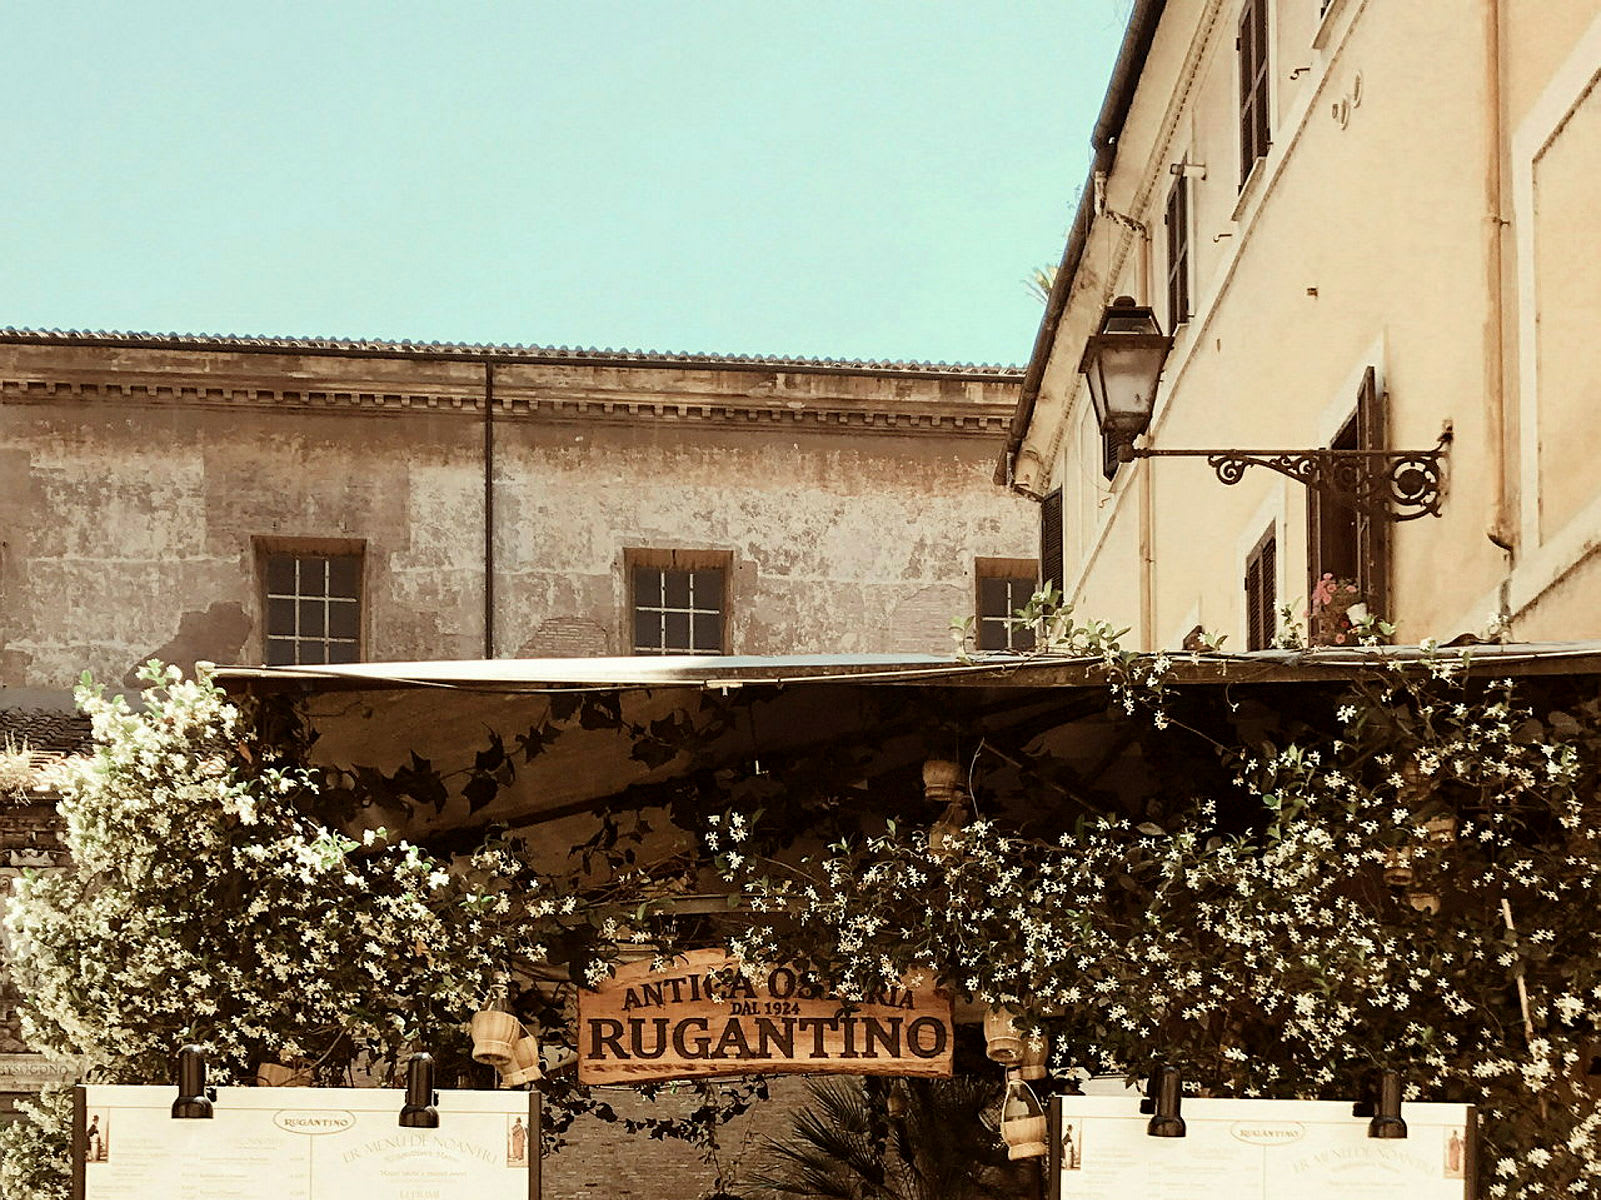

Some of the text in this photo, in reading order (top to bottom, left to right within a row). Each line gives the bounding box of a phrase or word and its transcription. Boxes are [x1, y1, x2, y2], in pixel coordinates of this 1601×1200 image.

[622, 966, 757, 1011] ANTICA
[730, 1000, 801, 1016] DAL 1924
[587, 1016, 948, 1060] RUGANTINO
[284, 1117, 348, 1128] RUGANTINO
